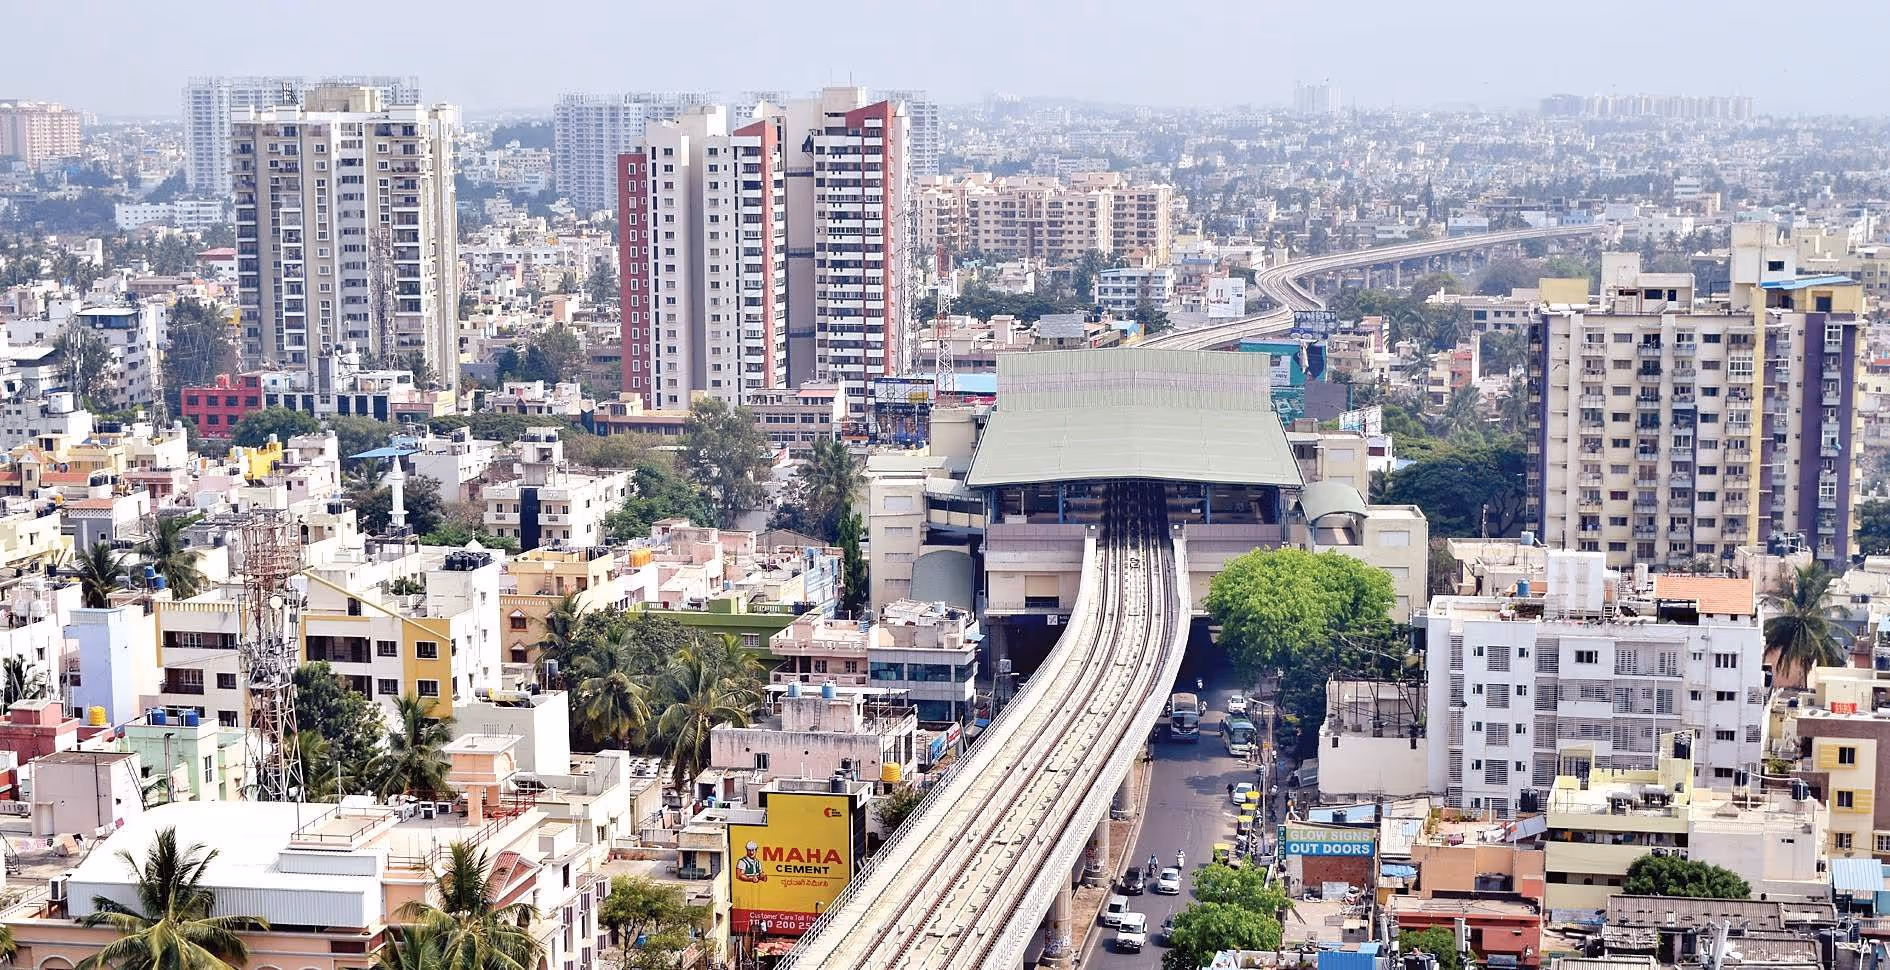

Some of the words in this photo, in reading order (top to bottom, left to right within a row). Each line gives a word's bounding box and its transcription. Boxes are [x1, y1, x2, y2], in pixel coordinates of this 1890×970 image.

[1290, 830, 1326, 840] GLOW
[1330, 830, 1370, 841] SIGNS
[1290, 843, 1319, 853] OUT
[1323, 843, 1370, 855] DOORS
[763, 847, 843, 865] MAHA
[775, 864, 830, 875] CEMENT
[749, 912, 778, 920] Customer
[806, 914, 817, 922] fre
[776, 920, 796, 929] 200
